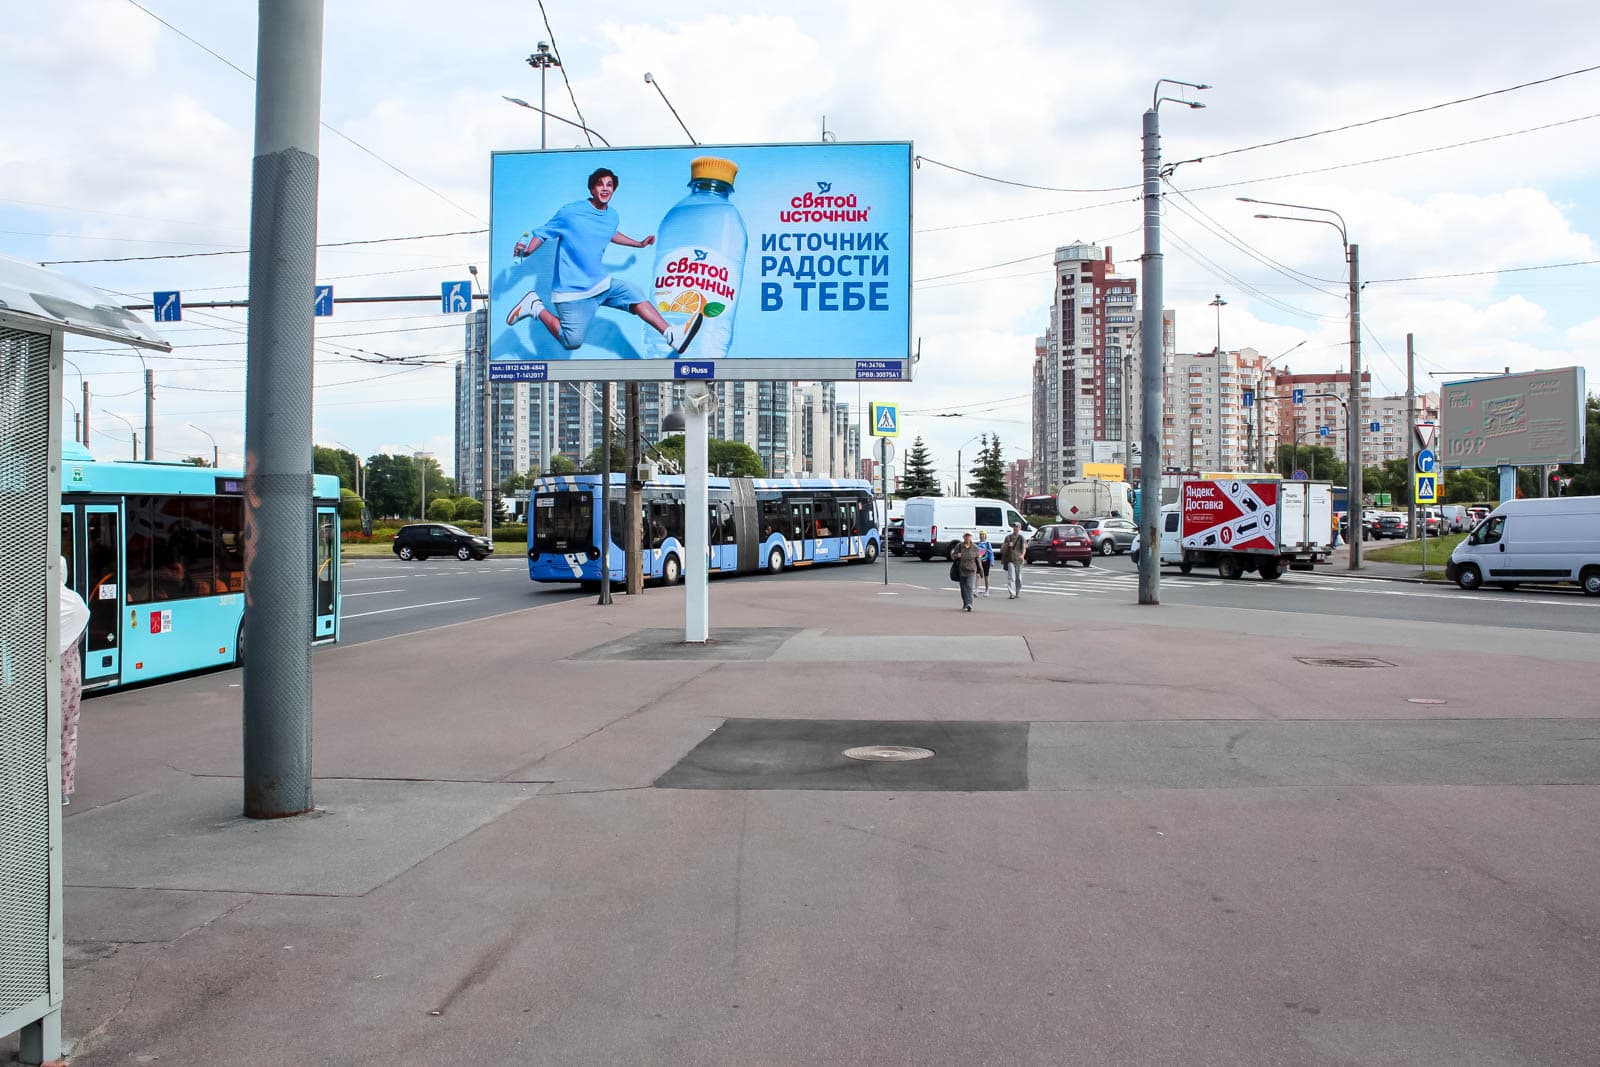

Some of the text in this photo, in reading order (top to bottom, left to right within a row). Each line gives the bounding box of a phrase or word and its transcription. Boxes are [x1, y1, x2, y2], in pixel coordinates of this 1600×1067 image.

[761, 232, 889, 251] ИСТОЧНИК
[761, 255, 889, 280] РАДОСТИ
[761, 281, 889, 311] В ТЕБЕ
[1186, 485, 1215, 498] Яндекс
[1185, 497, 1224, 511] Доставка
